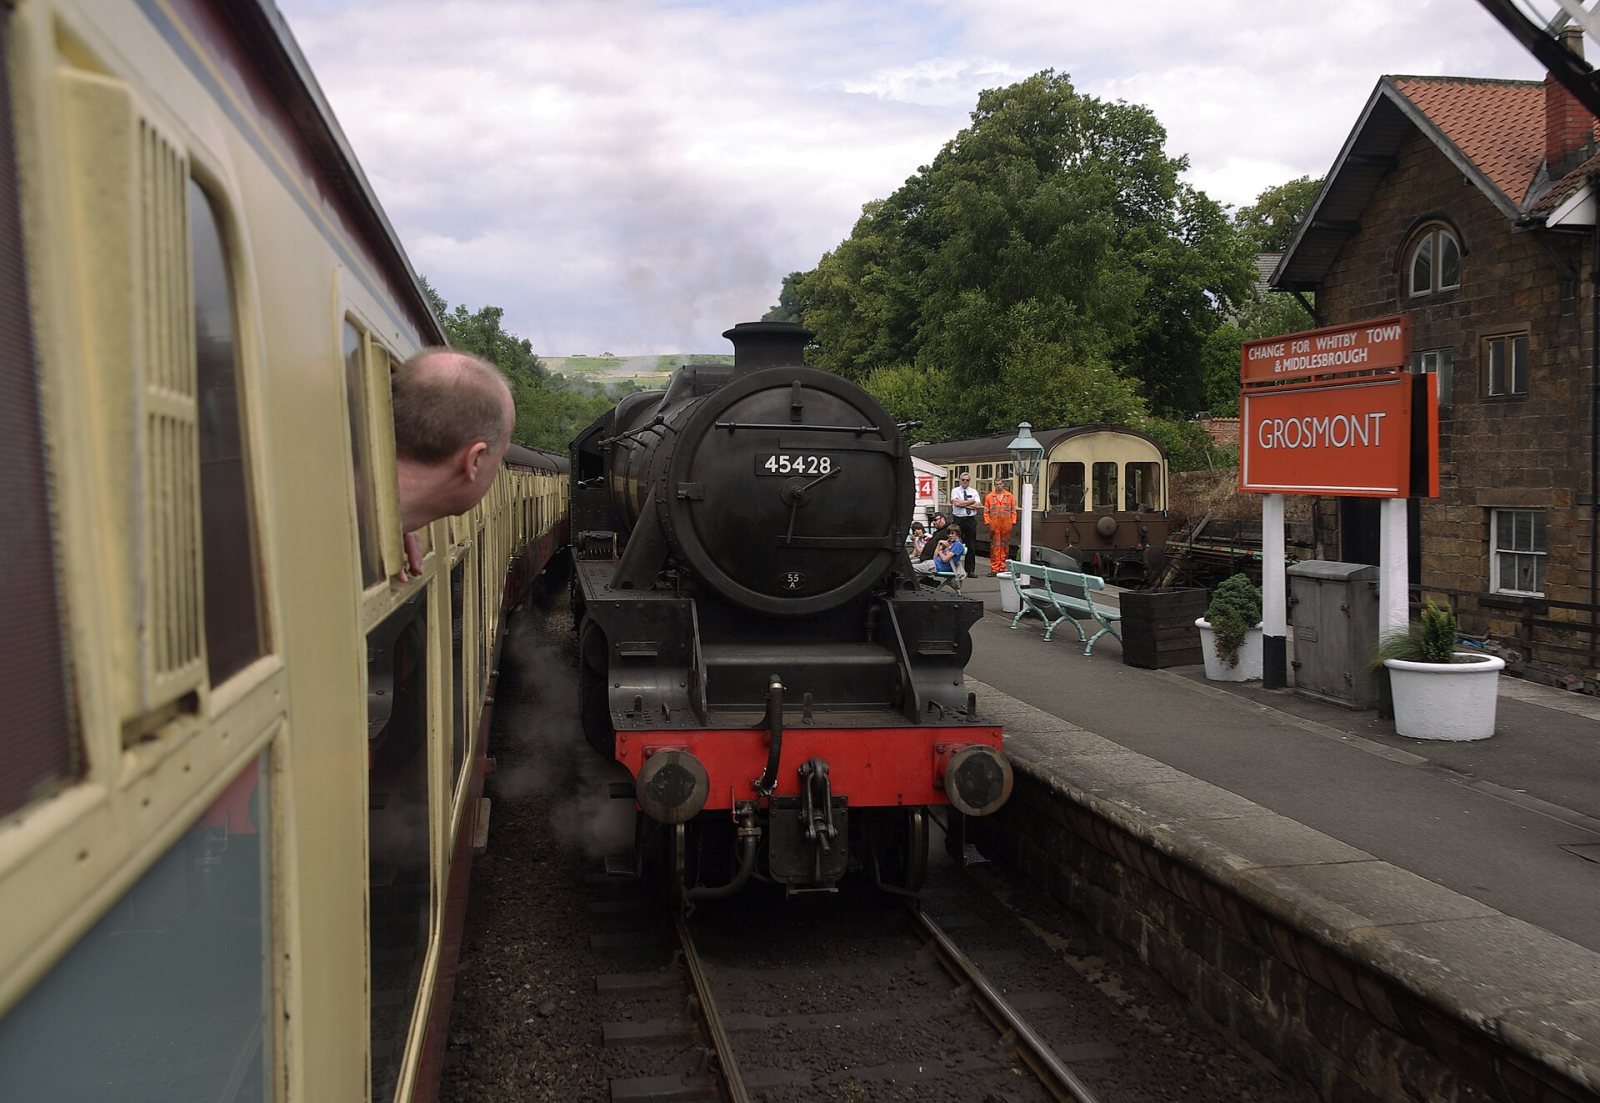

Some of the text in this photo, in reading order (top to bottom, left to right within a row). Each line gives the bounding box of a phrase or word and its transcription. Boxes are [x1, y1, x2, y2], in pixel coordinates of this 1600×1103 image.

[1248, 343, 1285, 360] CHANGE
[1291, 340, 1310, 354] FOR
[1316, 332, 1357, 350] WHITBY
[1274, 347, 1368, 373] & MIDDLESBROUGH
[1258, 412, 1387, 449] GROSMONT
[764, 455, 831, 474] 45428
[921, 481, 931, 495] 4
[787, 573, 799, 582] 55
